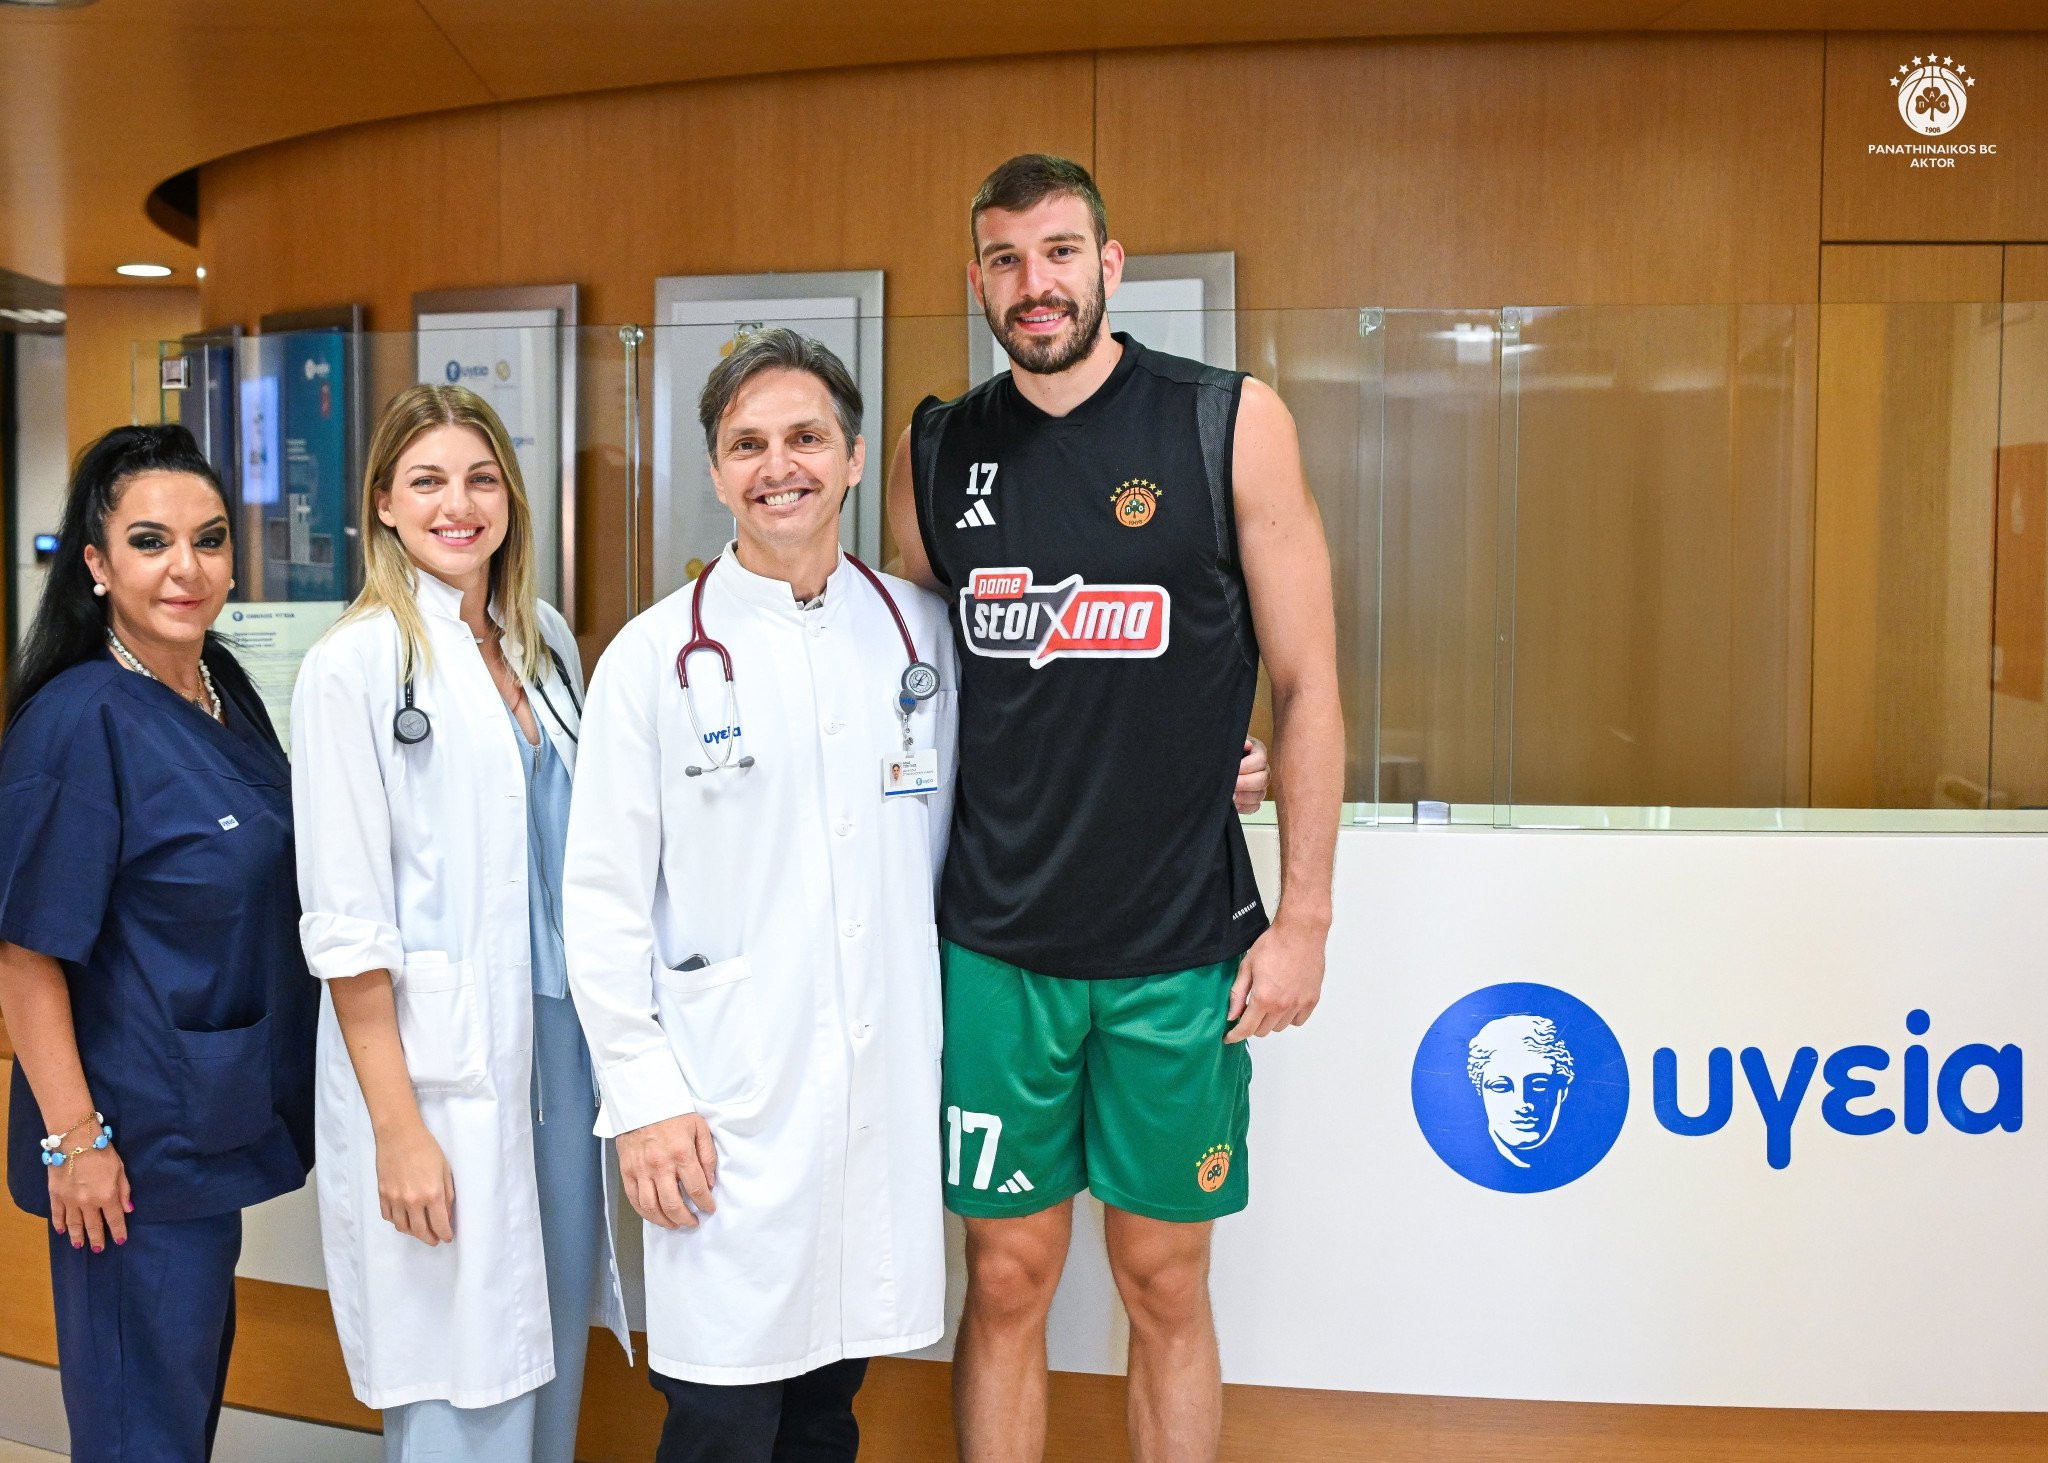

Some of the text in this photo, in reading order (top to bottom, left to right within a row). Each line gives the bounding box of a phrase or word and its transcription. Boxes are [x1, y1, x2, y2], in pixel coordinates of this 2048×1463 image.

[966, 462, 998, 495] 17
[977, 576, 1022, 597] pame
[947, 1105, 1003, 1190] 17
